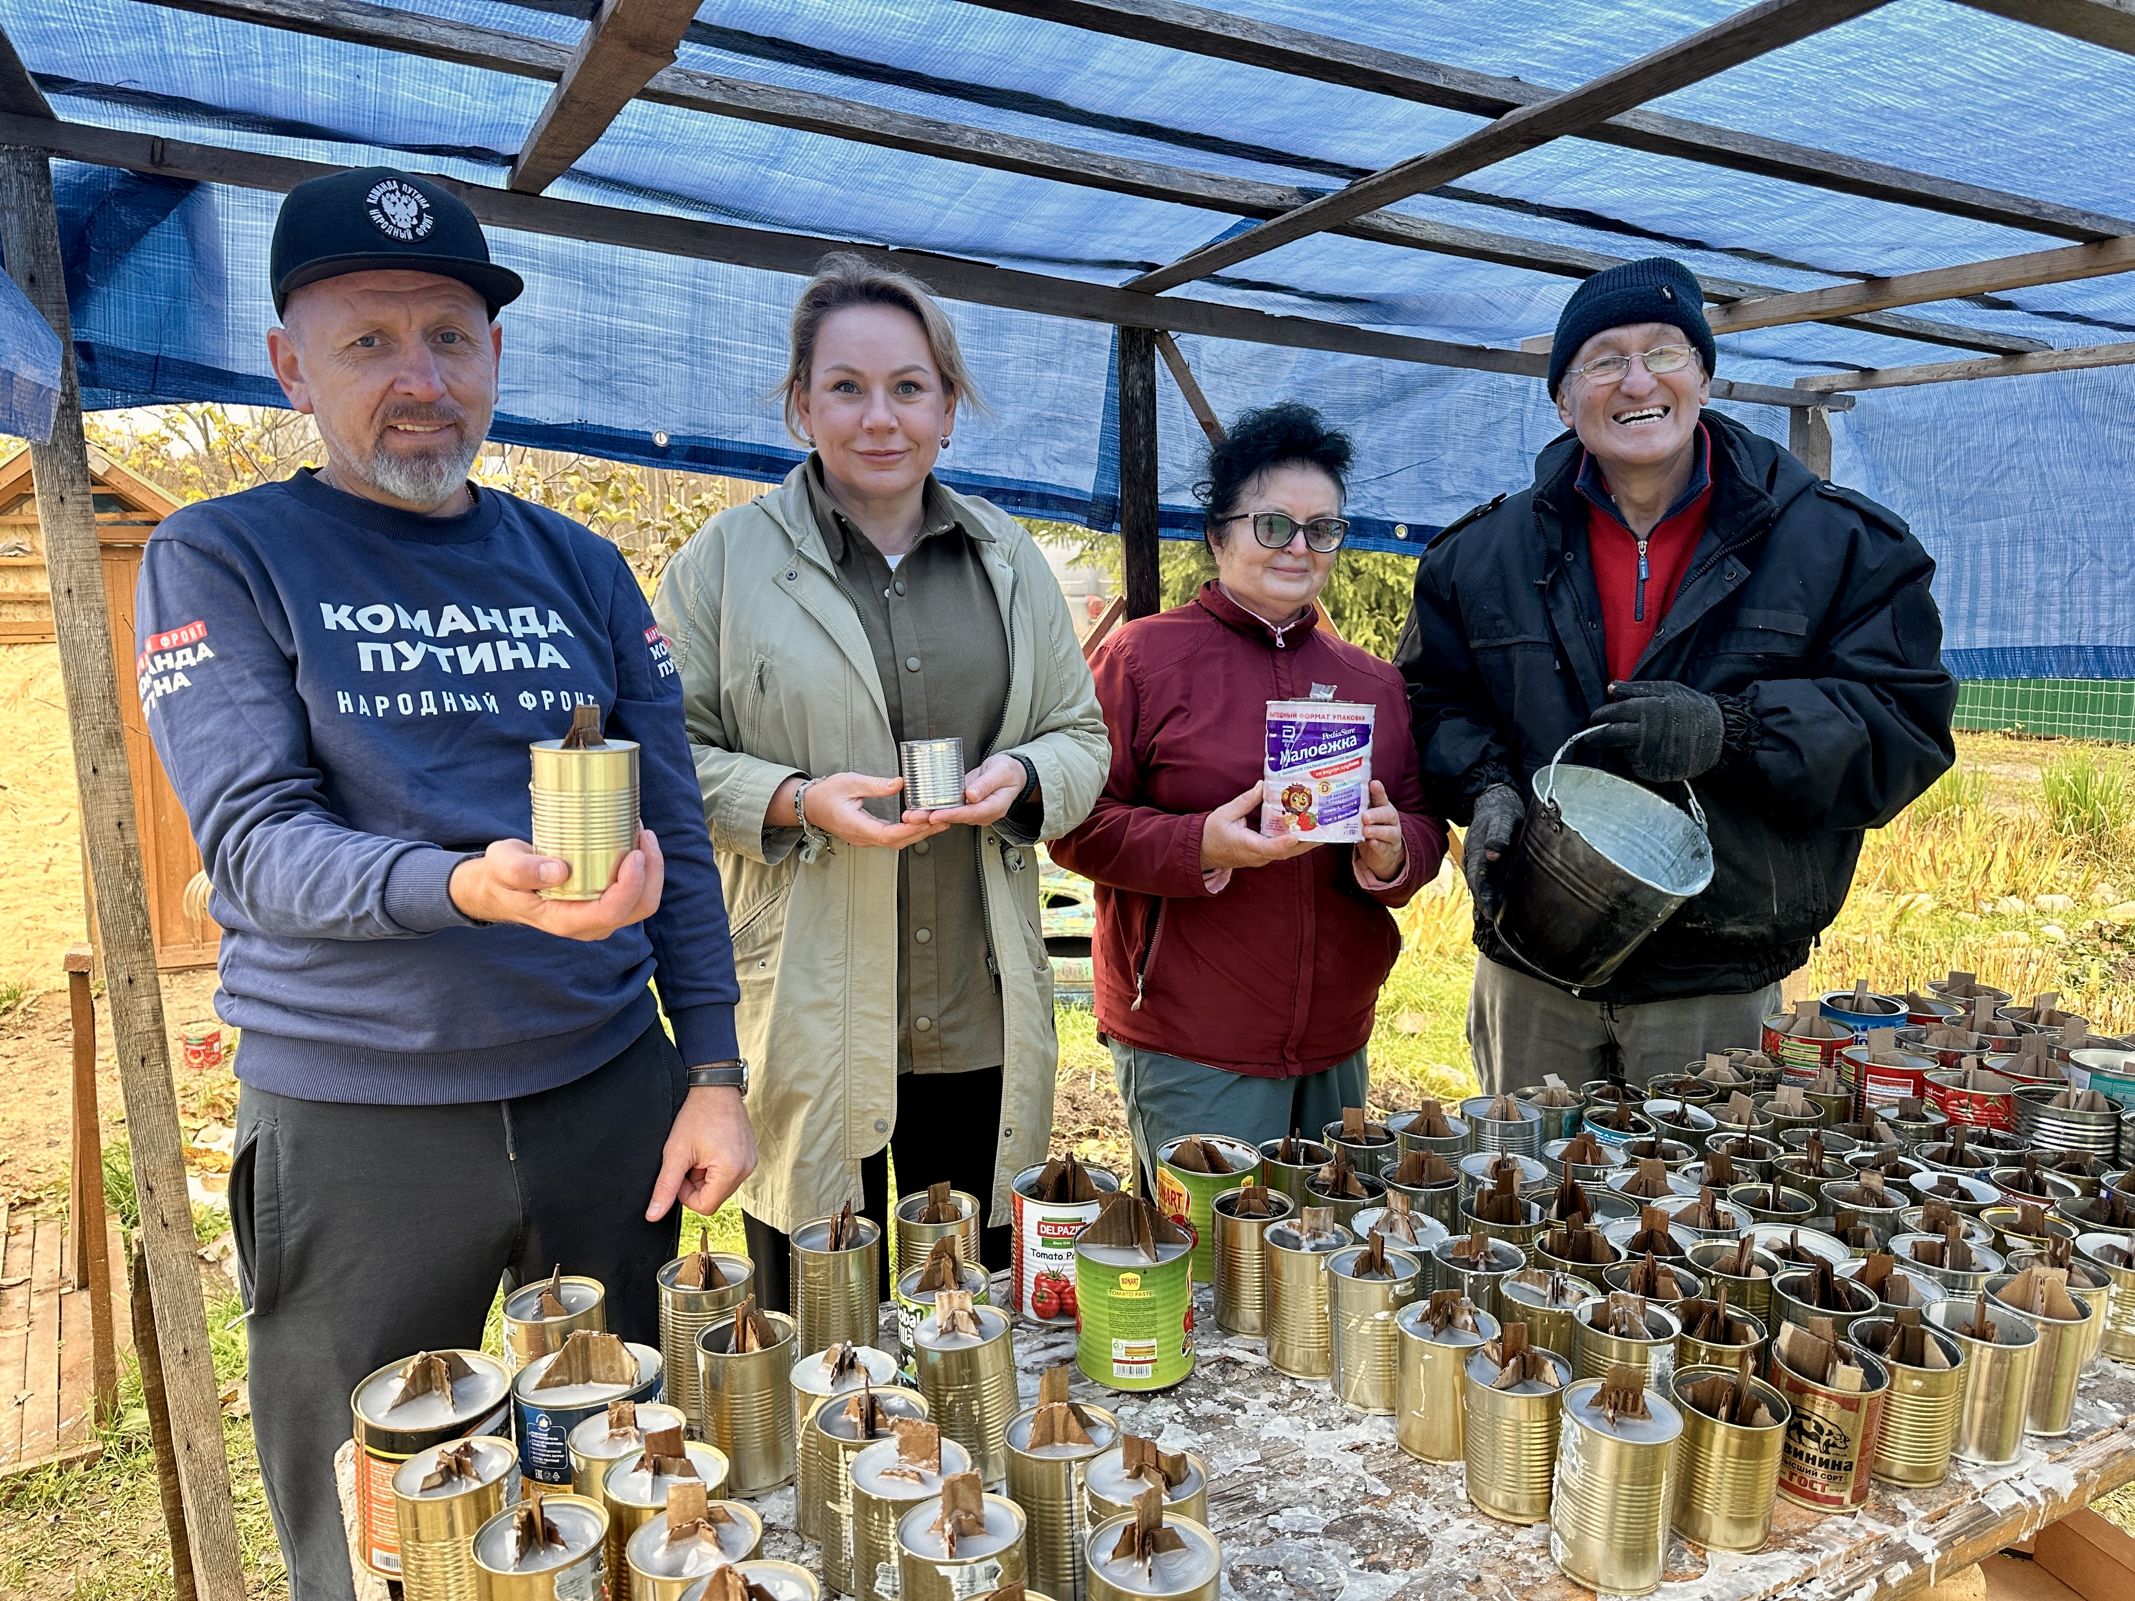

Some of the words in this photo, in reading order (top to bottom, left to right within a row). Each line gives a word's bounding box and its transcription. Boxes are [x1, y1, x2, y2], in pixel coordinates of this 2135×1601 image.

[366, 180, 399, 204] КОМАНДА
[402, 183, 430, 209] ПУТИНА
[368, 208, 413, 240] НАРОДНЫЙ
[415, 213, 434, 236] ФРОНТ
[319, 602, 575, 638] КОМАНДА
[160, 623, 203, 648] ФРОНТ
[356, 640, 571, 675] ПУТИНА
[336, 690, 500, 717] НАРОДНЫЙ
[1299, 712, 1330, 720] ФОРМАТ
[1322, 727, 1356, 740] PediaSure
[1280, 734, 1357, 767] Малоежка
[1030, 1247, 1063, 1260] Tomato
[1109, 1289, 1133, 1298] TOMATO
[1783, 1441, 1854, 1472] винина
[1787, 1470, 1830, 1493] ГОСТ
[1820, 1472, 1844, 1482] СОРТ
